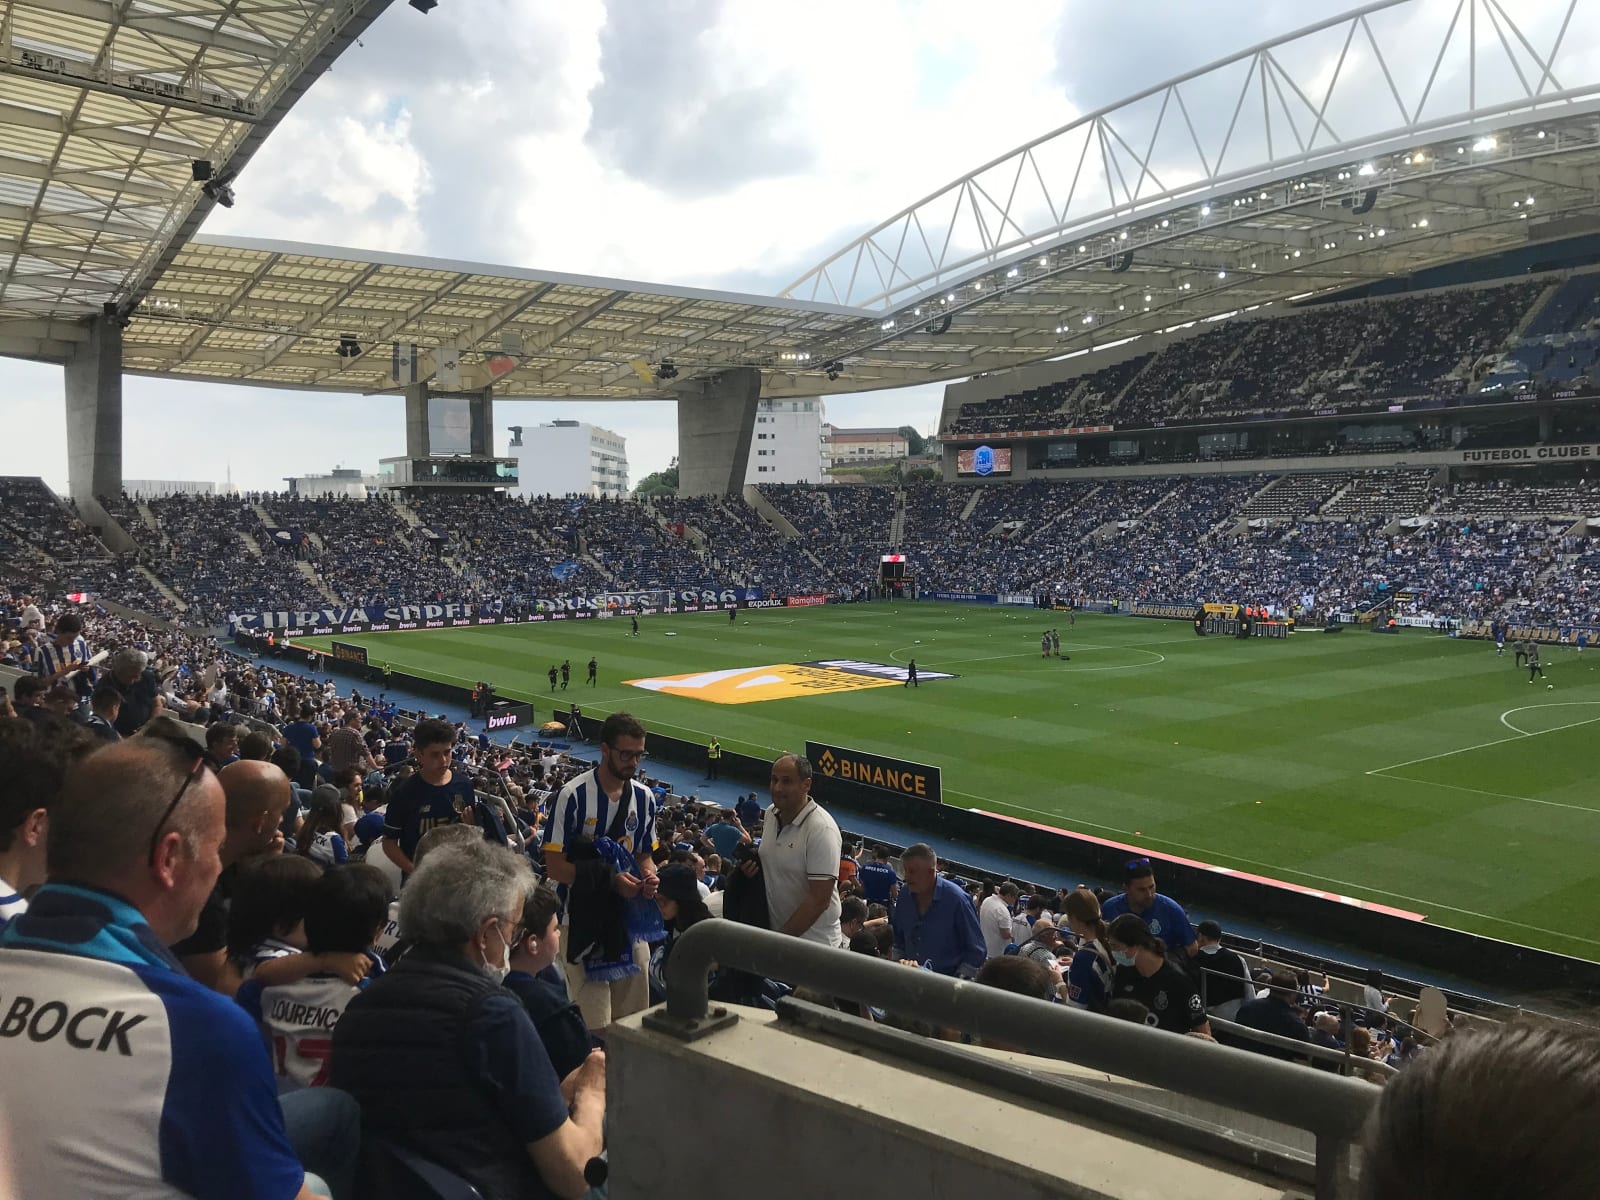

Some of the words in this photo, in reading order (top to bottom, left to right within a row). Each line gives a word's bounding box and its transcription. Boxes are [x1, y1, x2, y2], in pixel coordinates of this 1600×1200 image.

[1463, 449, 1531, 461] FUTEBOL
[1537, 446, 1590, 458] CLUBE
[235, 608, 370, 631] CURVA
[426, 619, 444, 627] bwin
[453, 618, 470, 626] bwin
[343, 625, 361, 633] bwin
[371, 623, 390, 631] bwin
[399, 621, 417, 629] bwin
[283, 628, 304, 636] bwin
[313, 626, 333, 635] bwin
[488, 712, 517, 729] bwin
[841, 758, 926, 796] BINANCE
[271, 999, 343, 1030] LOURENC
[0, 996, 149, 1057] BOCK
